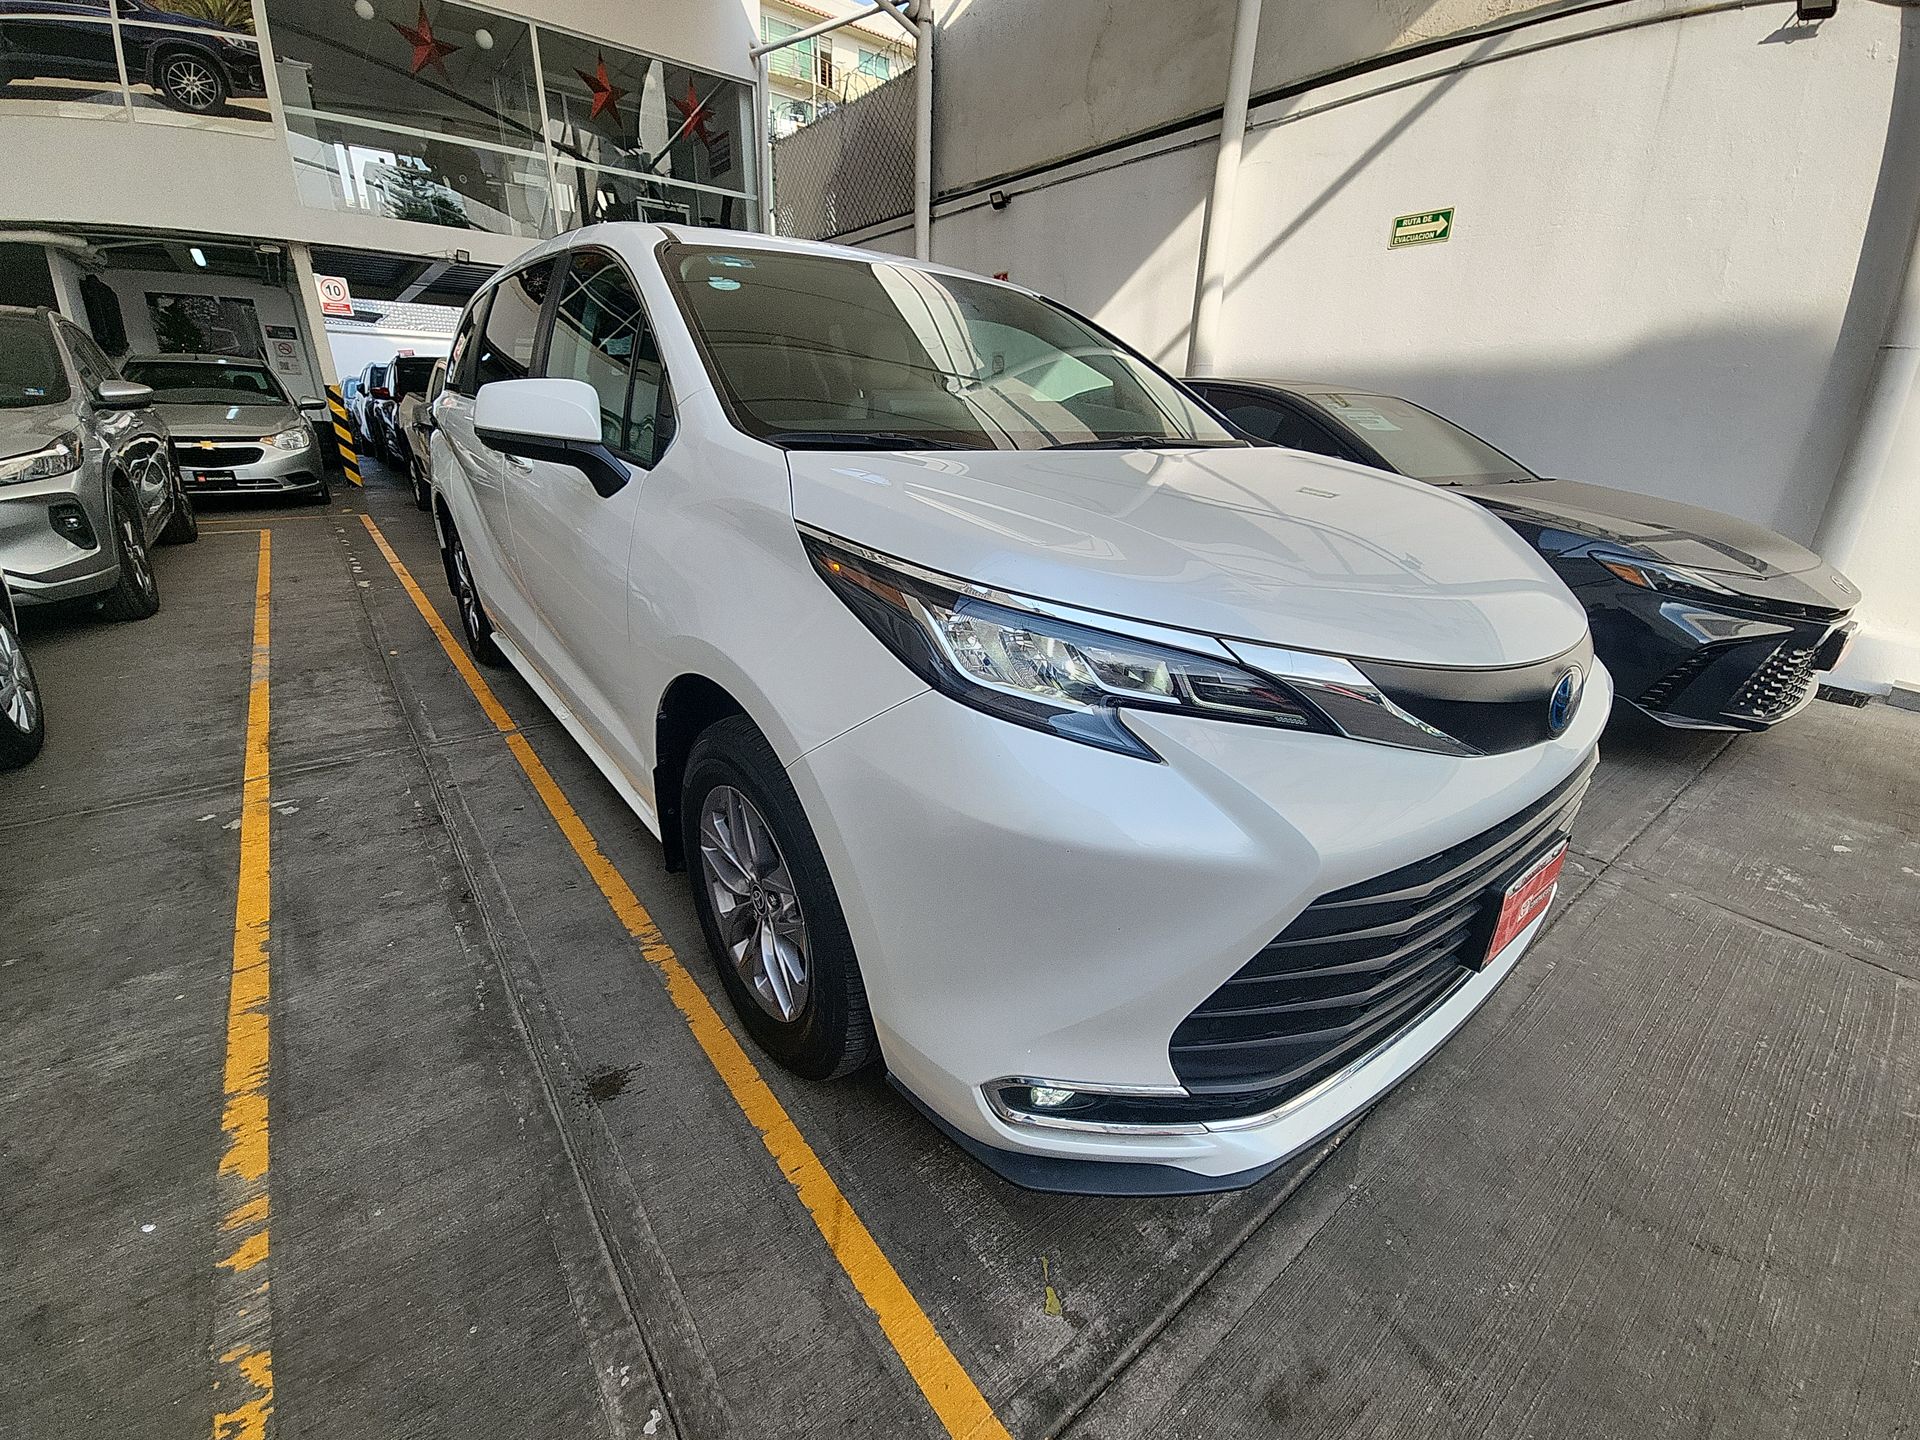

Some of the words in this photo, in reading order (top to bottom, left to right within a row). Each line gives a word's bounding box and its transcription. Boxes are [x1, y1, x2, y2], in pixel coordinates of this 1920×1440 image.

[1402, 217, 1421, 226] RUTA
[1422, 215, 1433, 223] DE
[325, 284, 341, 296] 10
